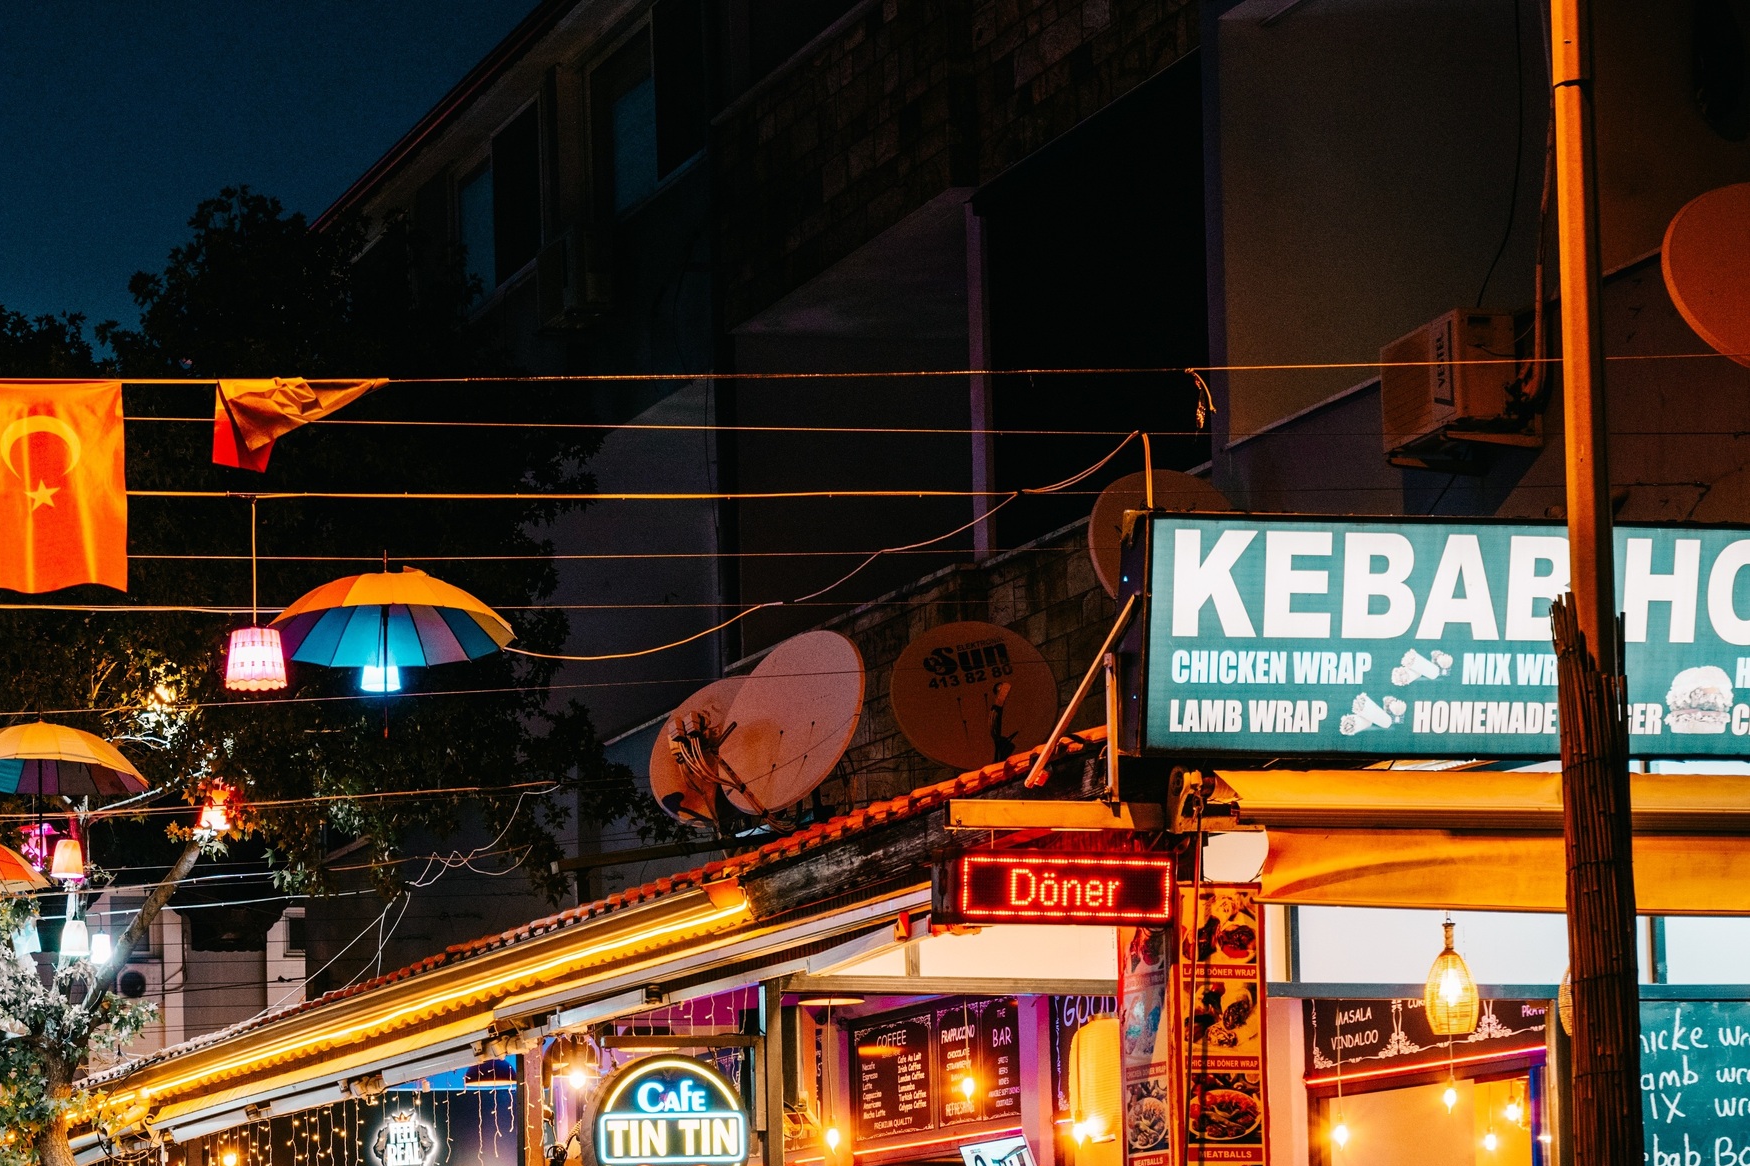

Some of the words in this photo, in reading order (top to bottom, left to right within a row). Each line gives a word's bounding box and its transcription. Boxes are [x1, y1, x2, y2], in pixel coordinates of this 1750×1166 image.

[1172, 529, 1571, 640] KEBAB
[1171, 650, 1287, 684] CHICKEN
[1292, 651, 1372, 685] WRAP
[1461, 653, 1511, 685] MIX
[929, 675, 960, 689] 413
[1169, 699, 1243, 733] LAMB
[1248, 700, 1328, 733] WRAP
[1412, 701, 1557, 734] HOMEMADE
[1009, 867, 1122, 907] Döner
[1235, 968, 1257, 976] WRAP
[1336, 1006, 1372, 1026] MASALA
[877, 1029, 907, 1048] COFFEE
[941, 1024, 976, 1045] FRAPPUCCNO
[992, 1026, 1012, 1048] BAR
[1330, 1030, 1379, 1051] VINDALOO
[1240, 1060, 1258, 1068] WRAP
[607, 1118, 667, 1157] TIN
[678, 1118, 738, 1156] TIN
[387, 1142, 422, 1166] REAL
[1200, 1150, 1252, 1159] MEATBALLS
